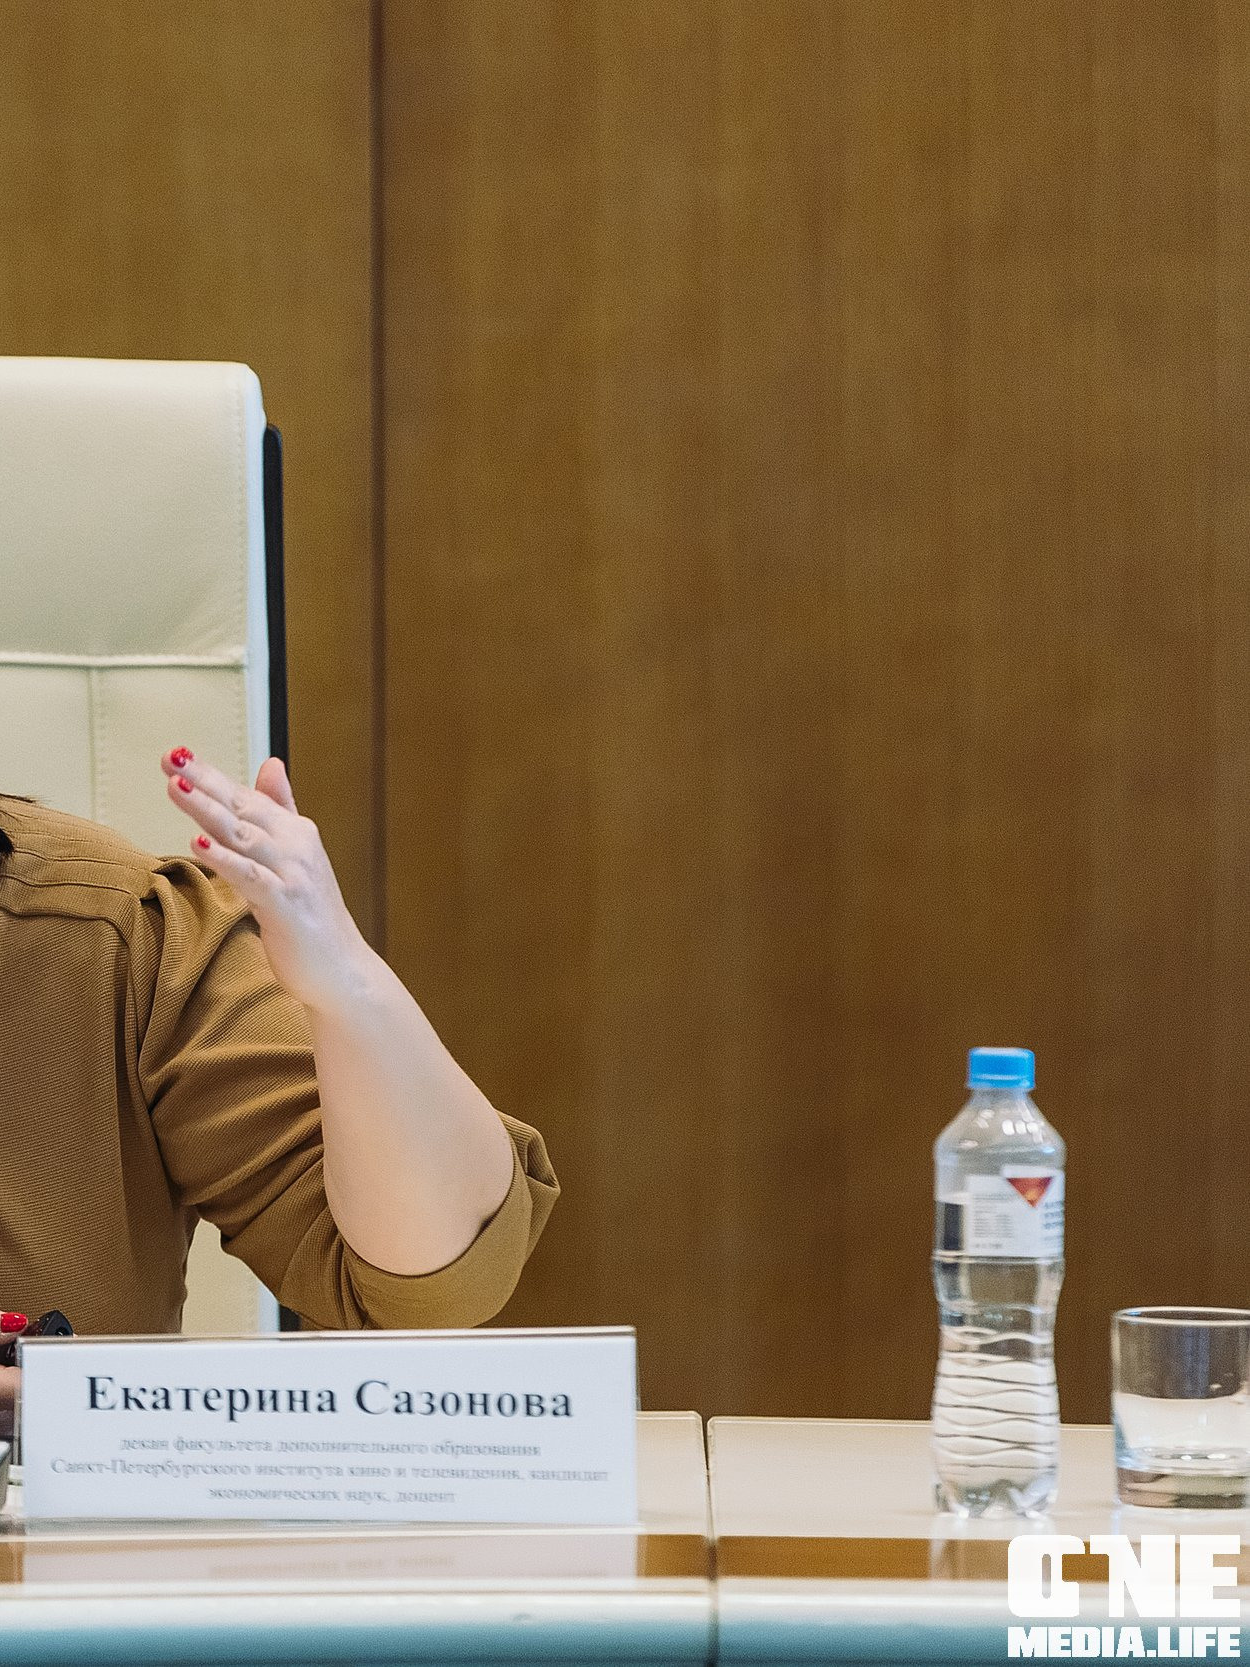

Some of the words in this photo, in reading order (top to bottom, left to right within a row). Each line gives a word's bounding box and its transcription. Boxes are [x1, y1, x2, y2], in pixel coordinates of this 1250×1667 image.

[85, 1376, 338, 1422] Екатерина
[354, 1379, 573, 1417] Сазонова
[119, 1439, 169, 1451] декан
[173, 1436, 272, 1454] факультета
[277, 1440, 429, 1455] дополнительного
[431, 1440, 541, 1458] образования
[50, 1458, 251, 1478] Санкт-Петербургского
[255, 1464, 344, 1480] института
[347, 1466, 391, 1477] кино
[397, 1467, 407, 1477] и
[528, 1469, 609, 1482] кандидат
[208, 1487, 340, 1501] экономических
